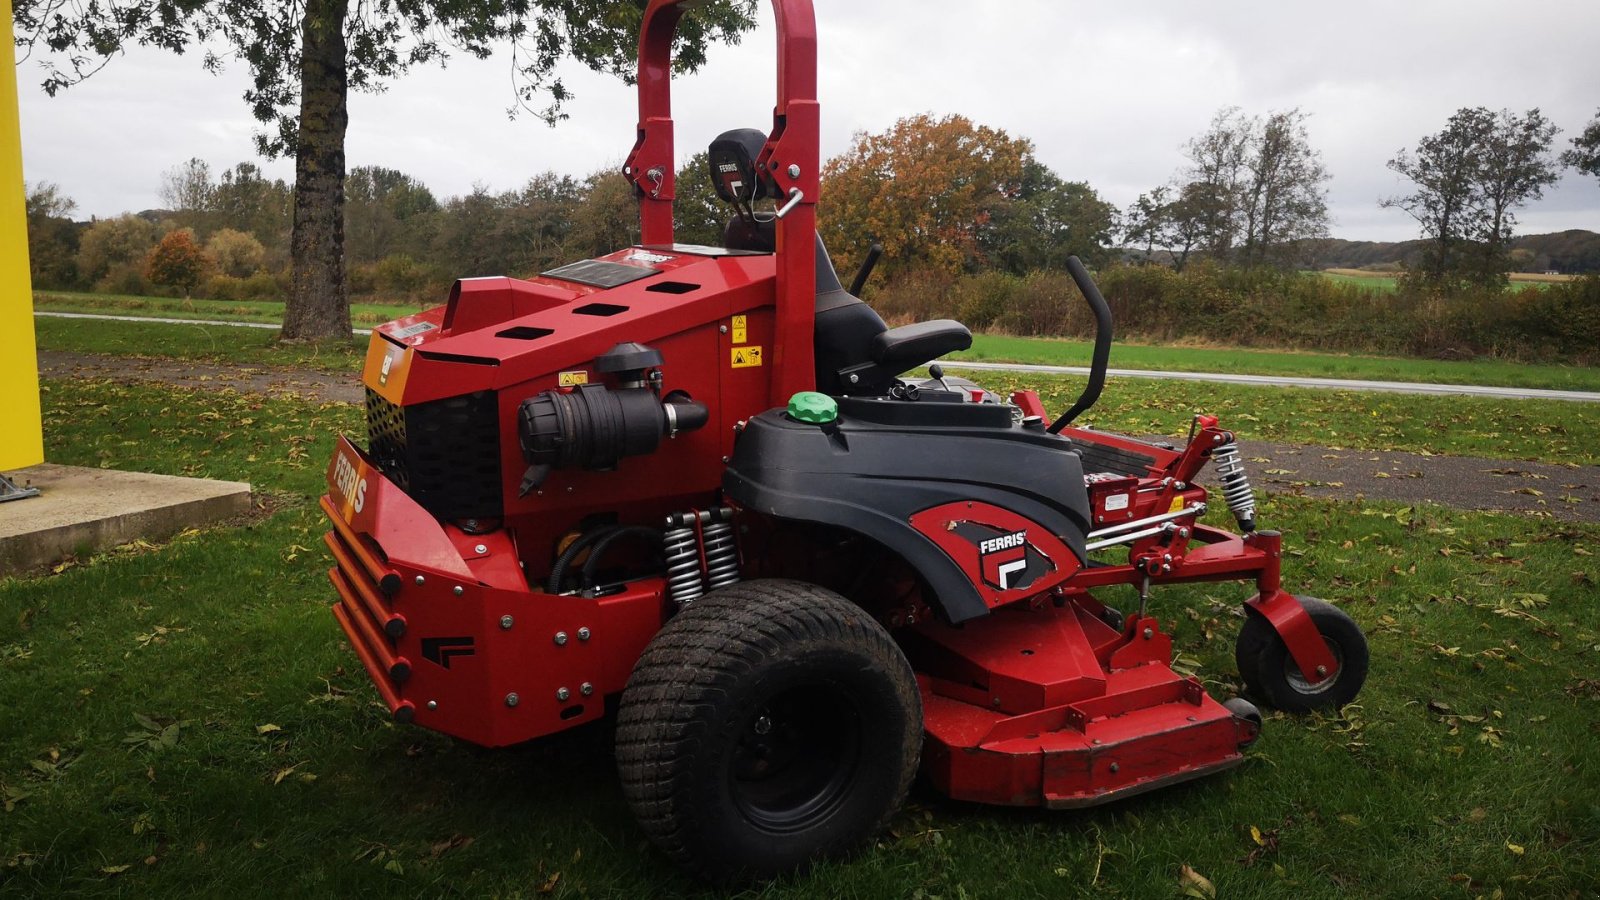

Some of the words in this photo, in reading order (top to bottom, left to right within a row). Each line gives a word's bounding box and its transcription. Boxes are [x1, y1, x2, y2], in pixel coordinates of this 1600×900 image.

[719, 163, 738, 173] FERRIS
[333, 449, 367, 513] FERRIS
[980, 532, 1025, 554] FERRIS
